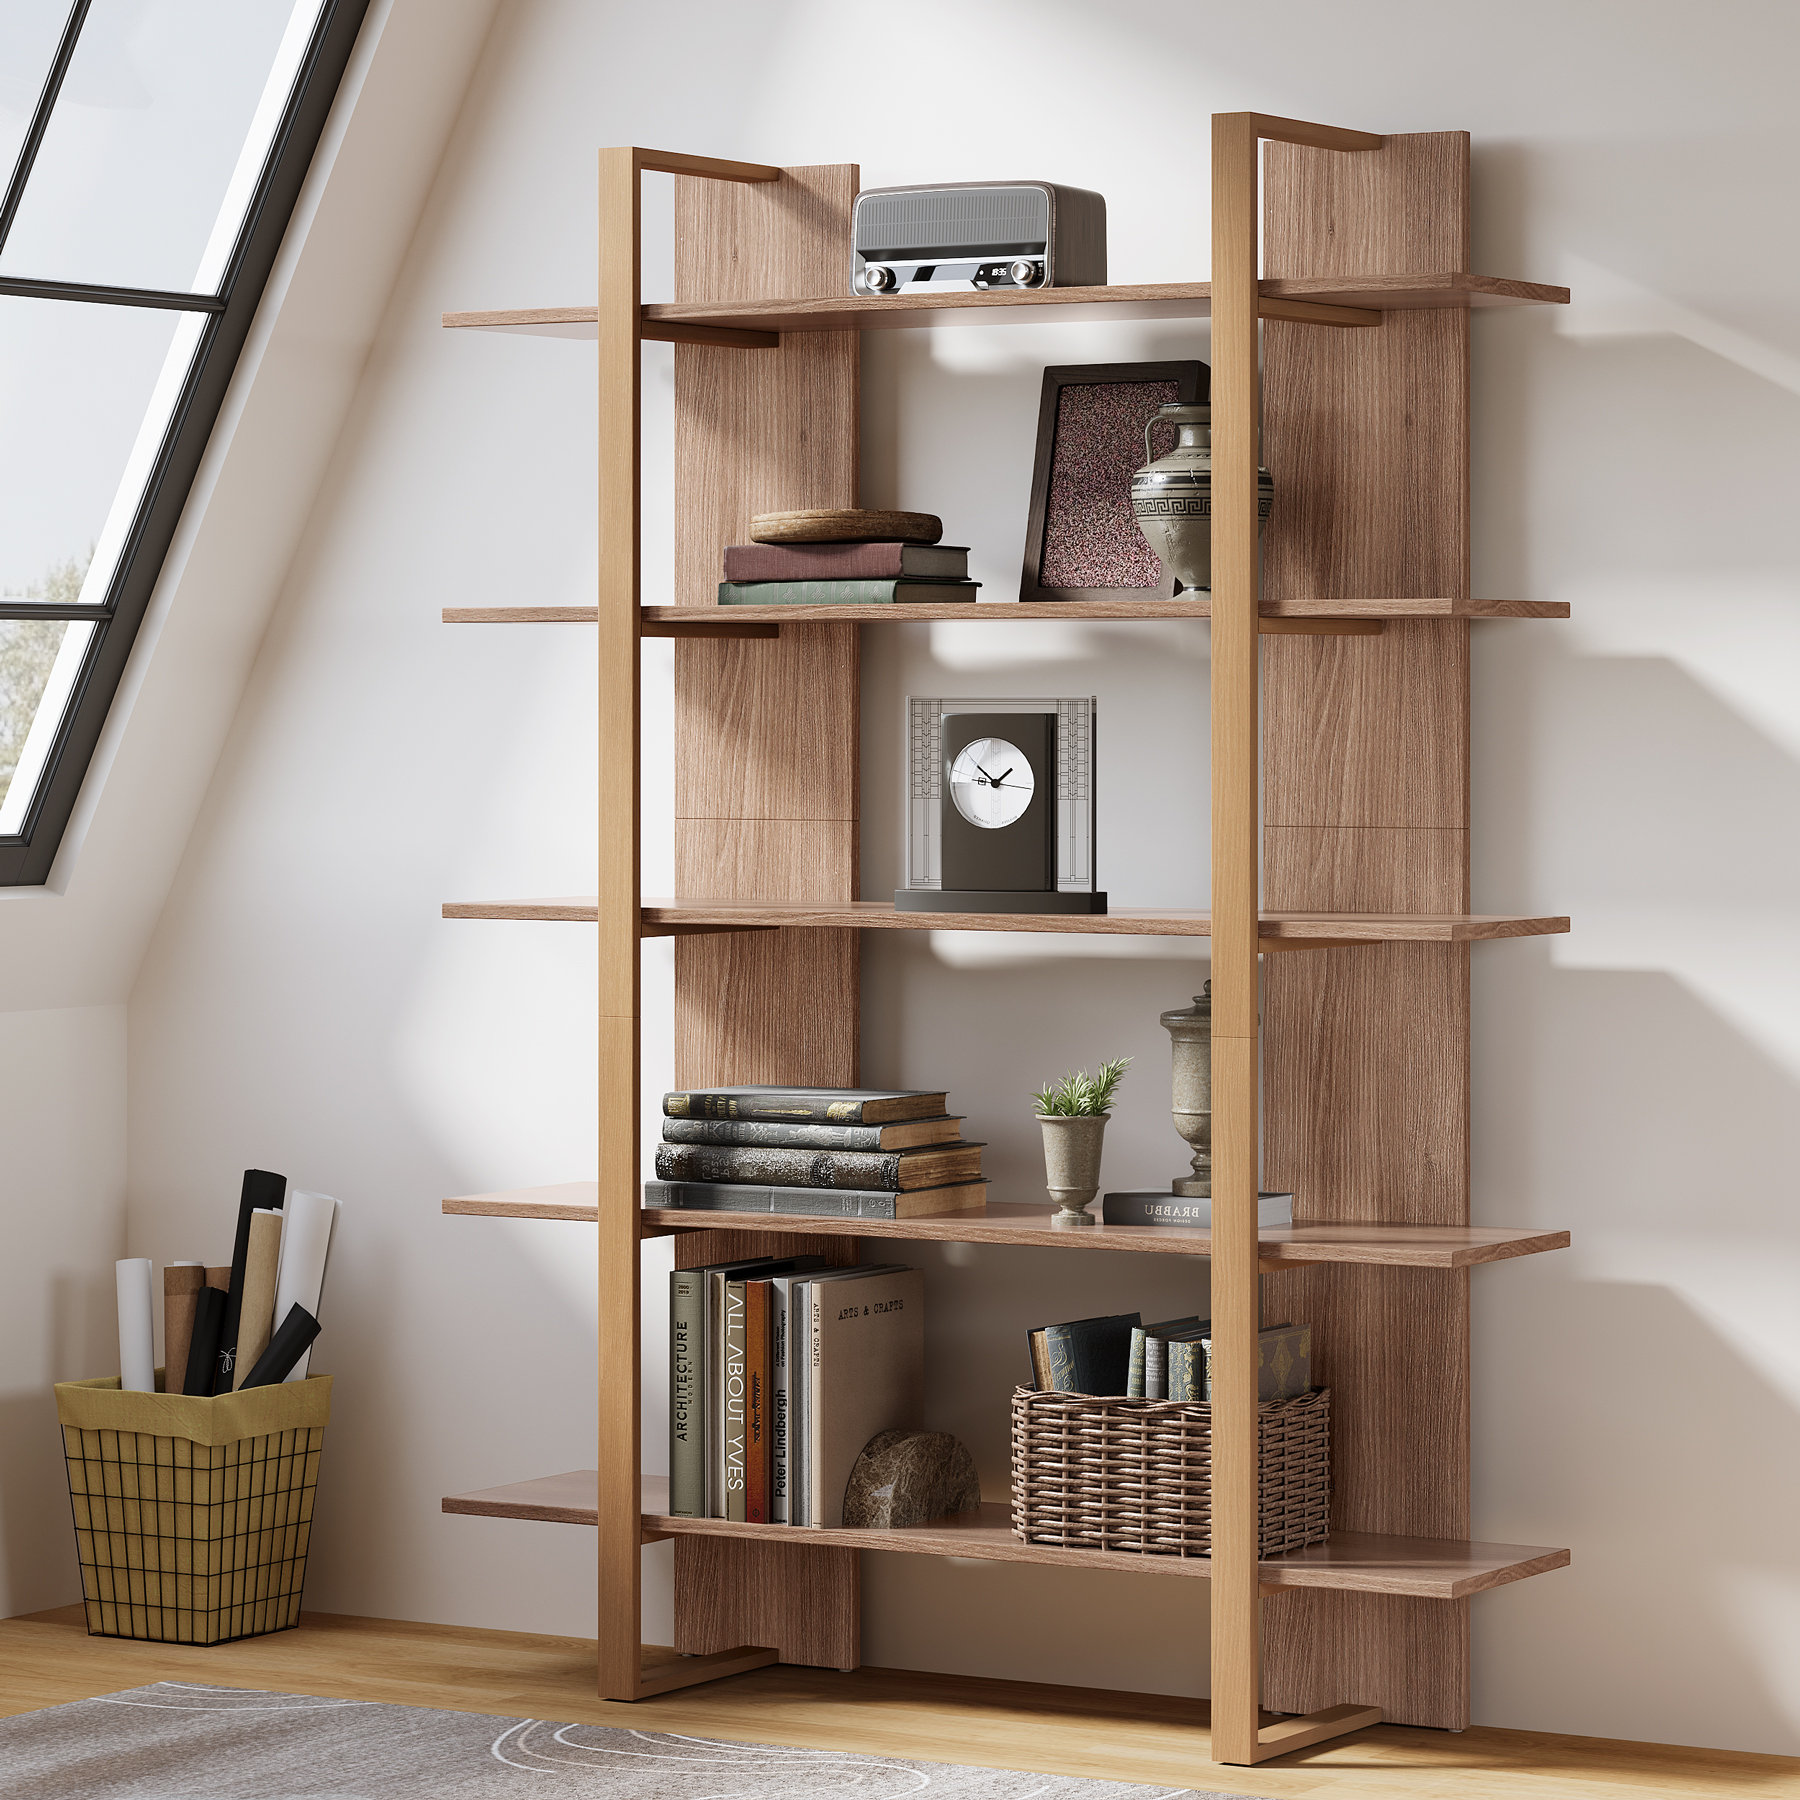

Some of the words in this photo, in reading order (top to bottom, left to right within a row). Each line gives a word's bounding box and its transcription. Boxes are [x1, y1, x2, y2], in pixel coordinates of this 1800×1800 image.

[728, 1293, 744, 1337] ALL
[838, 1306, 859, 1321] ARTS
[863, 1305, 870, 1316] &
[873, 1299, 904, 1314] CRAFTS
[676, 1320, 688, 1442] ARCHITECTURE
[728, 1343, 744, 1424] ABOUT
[775, 1389, 788, 1458] Lindbergh
[728, 1434, 744, 1491] YVES
[775, 1462, 786, 1498] Peter
